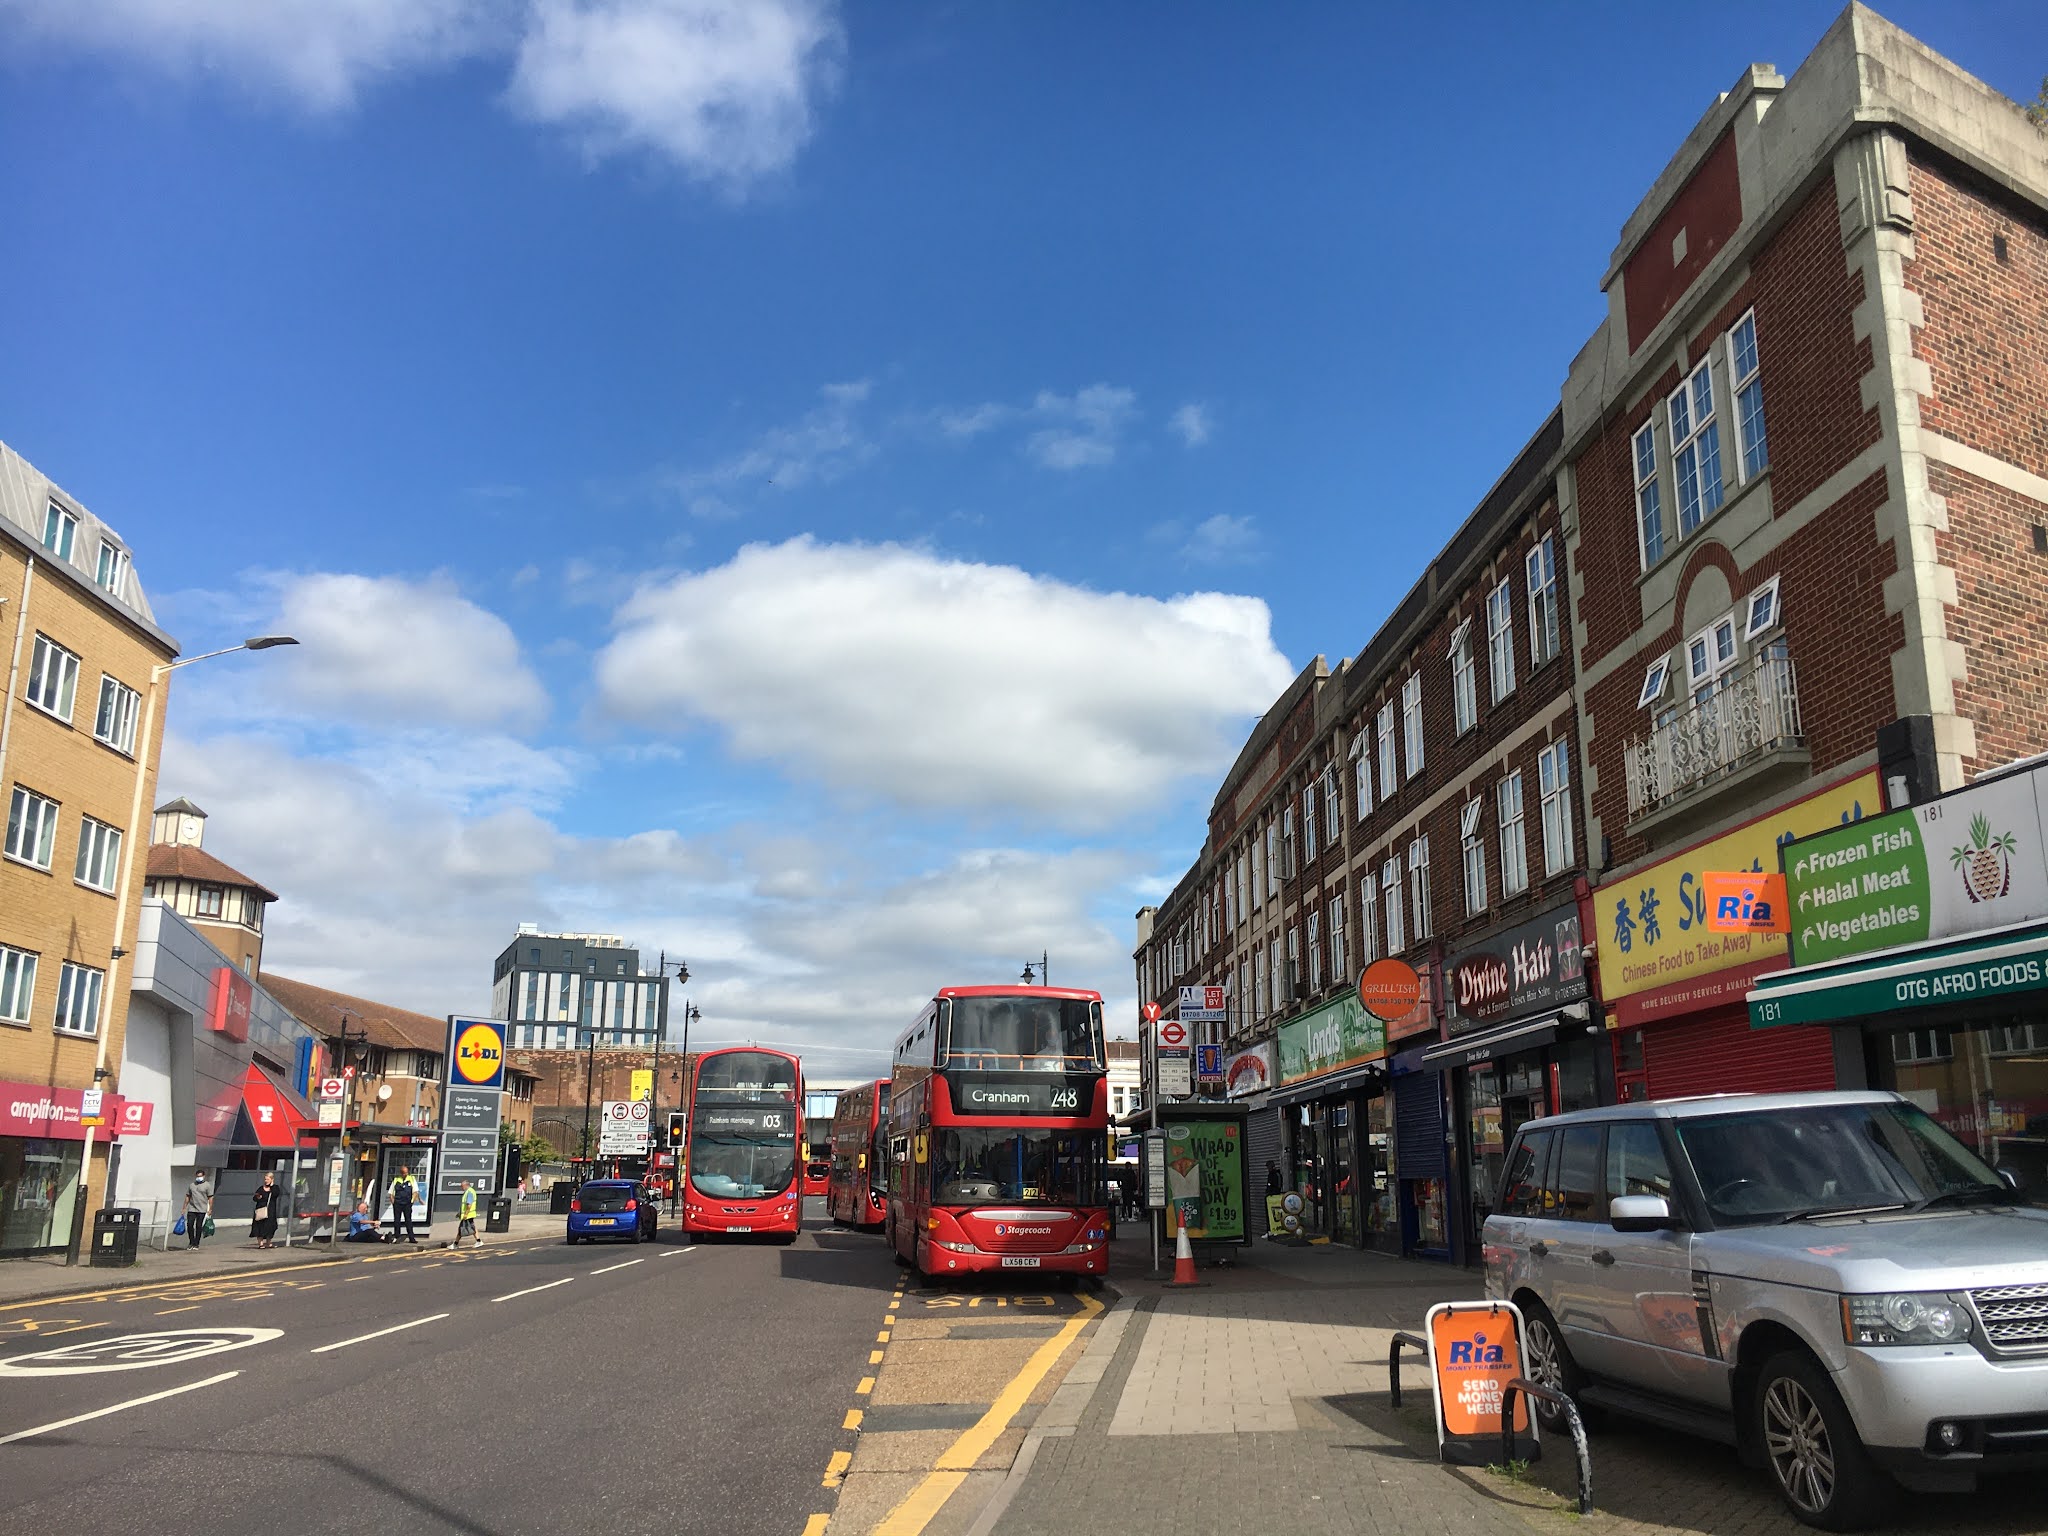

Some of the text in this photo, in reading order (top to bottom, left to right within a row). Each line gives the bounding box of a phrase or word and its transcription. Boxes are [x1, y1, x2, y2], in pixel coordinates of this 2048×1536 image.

[1923, 805, 1943, 823] 181
[1809, 827, 1913, 873] Frozen Fish
[1813, 864, 1912, 907] Halal Meat
[1717, 888, 1771, 920] Ria
[1816, 904, 1920, 942] Vegetables
[1622, 963, 1657, 984] Chinese
[1659, 950, 1682, 974] Food
[1684, 949, 1695, 967] to
[1696, 942, 1720, 962] Take
[1722, 934, 1752, 956] Away
[1459, 937, 1552, 1006] Divine Hair
[1895, 979, 1930, 1001] OTG
[1933, 971, 1976, 996] AFRO
[1979, 960, 2041, 989] FOODS
[1206, 990, 1221, 998] LET
[1365, 983, 1417, 994] GRILL'ISH
[1641, 1000, 1659, 1010] HOME
[1660, 992, 1690, 1007] DELIVERY
[1693, 985, 1722, 999] SERVICE
[1146, 1005, 1157, 1018] Y
[1208, 998, 1219, 1006] BY
[1758, 1002, 1782, 1022] 181
[1307, 1013, 1341, 1063] Londis
[343, 1070, 354, 1078] X
[971, 1087, 1078, 1108] Cranham 248
[11, 1098, 64, 1124] amplifon
[763, 1114, 781, 1128] 103
[1190, 1137, 1235, 1160] WRAP
[1205, 1156, 1220, 1169] OF
[1201, 1170, 1225, 1186] THE
[1202, 1186, 1230, 1206] DAY
[1209, 1207, 1238, 1221] £1.99
[1007, 1226, 1051, 1235] Stagecoach
[1004, 1258, 1038, 1266] LX58 CEY
[1449, 1331, 1505, 1364] Ria
[1474, 1363, 1513, 1371] TRANSFER
[1462, 1379, 1499, 1392] SEND
[1466, 1403, 1503, 1415] HERE
